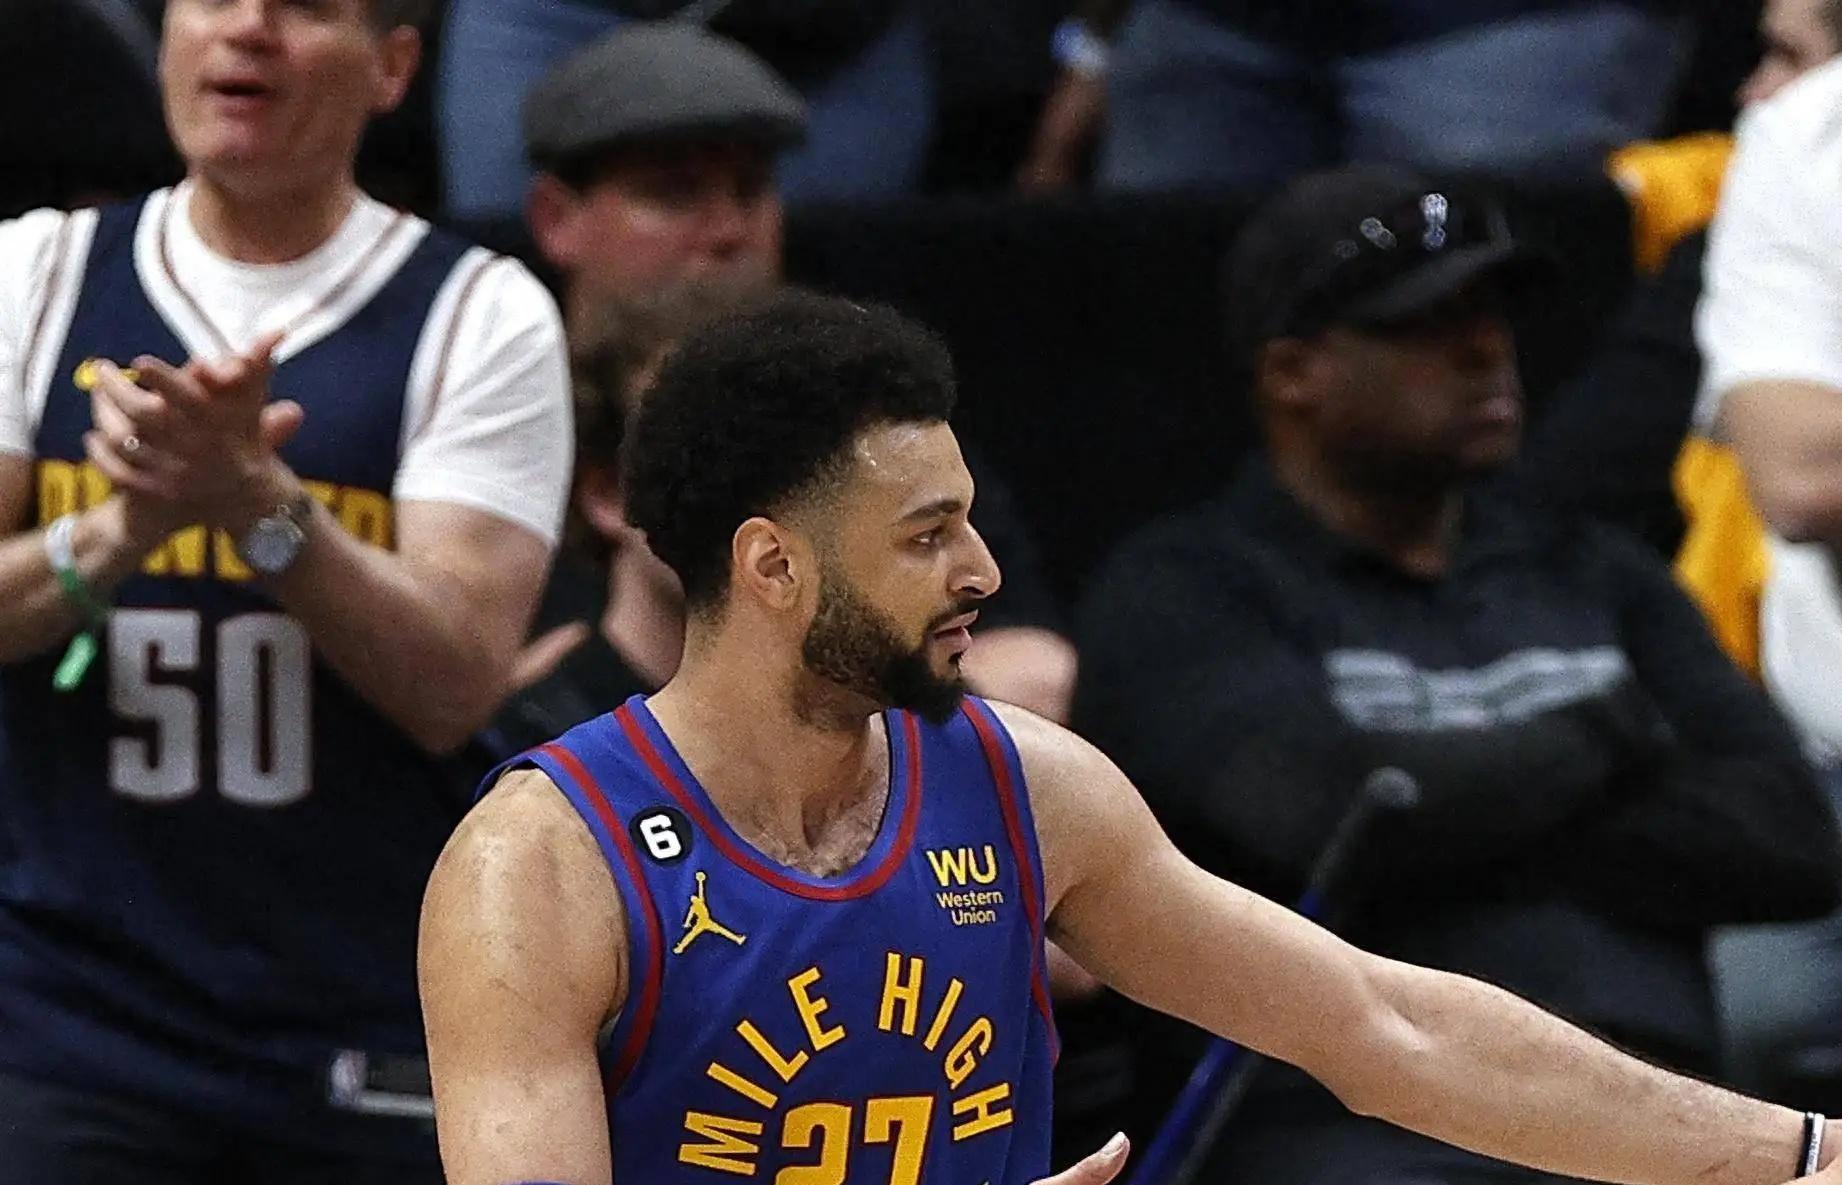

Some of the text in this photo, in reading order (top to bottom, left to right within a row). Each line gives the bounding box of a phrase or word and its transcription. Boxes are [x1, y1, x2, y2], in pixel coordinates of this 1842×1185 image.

[107, 608, 313, 805] 50
[639, 813, 682, 860] 6
[926, 845, 997, 887] WU
[936, 890, 1004, 908] Western
[951, 906, 996, 926] Union
[678, 952, 1013, 1176] MILE HIGH
